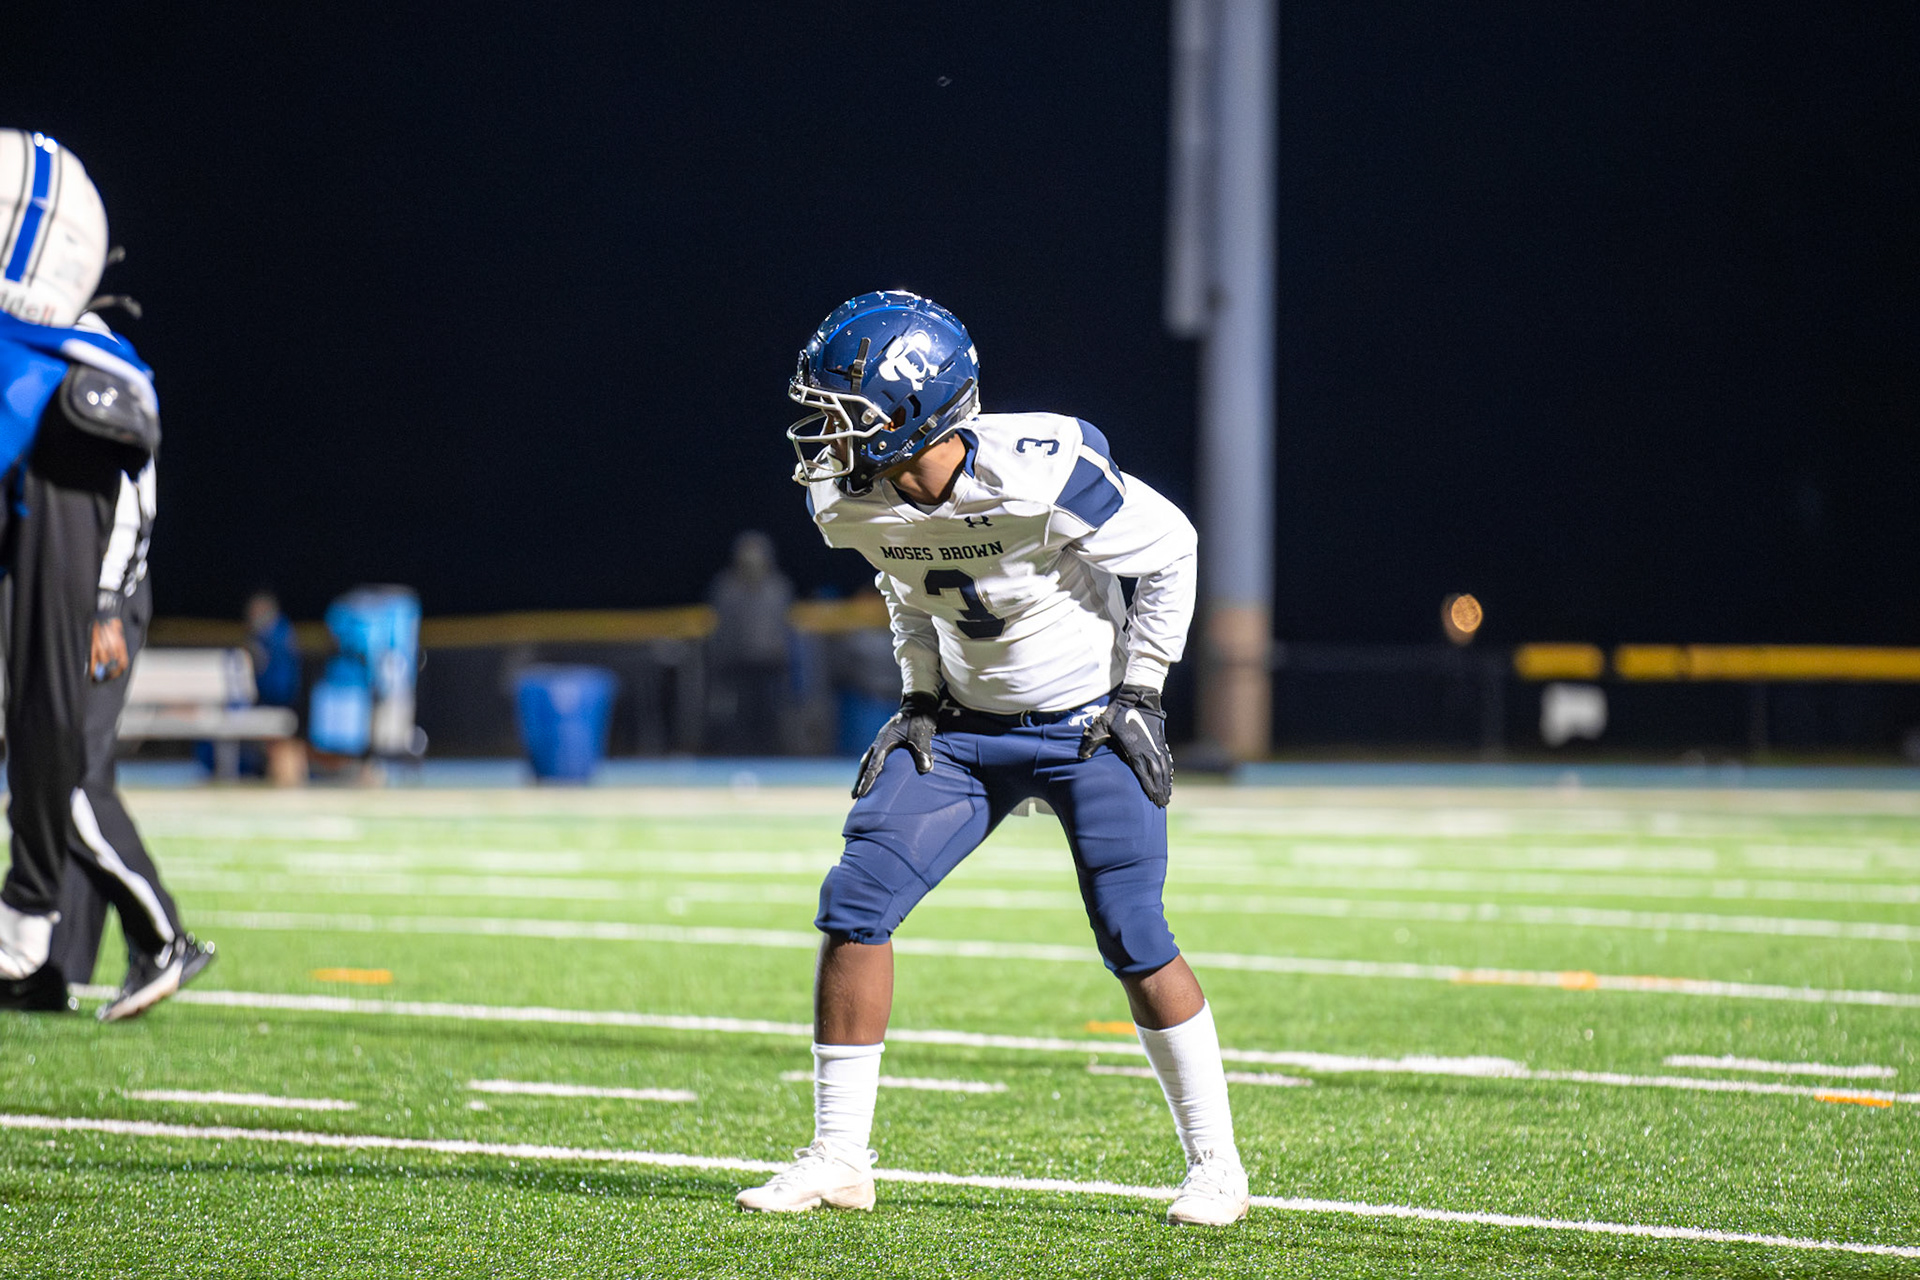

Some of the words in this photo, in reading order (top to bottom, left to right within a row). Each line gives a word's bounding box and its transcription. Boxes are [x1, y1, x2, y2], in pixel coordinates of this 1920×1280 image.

[1014, 437, 1060, 456] 3
[880, 545, 934, 561] MOSES
[938, 540, 1004, 561] BROWN
[923, 568, 1006, 639] 3
